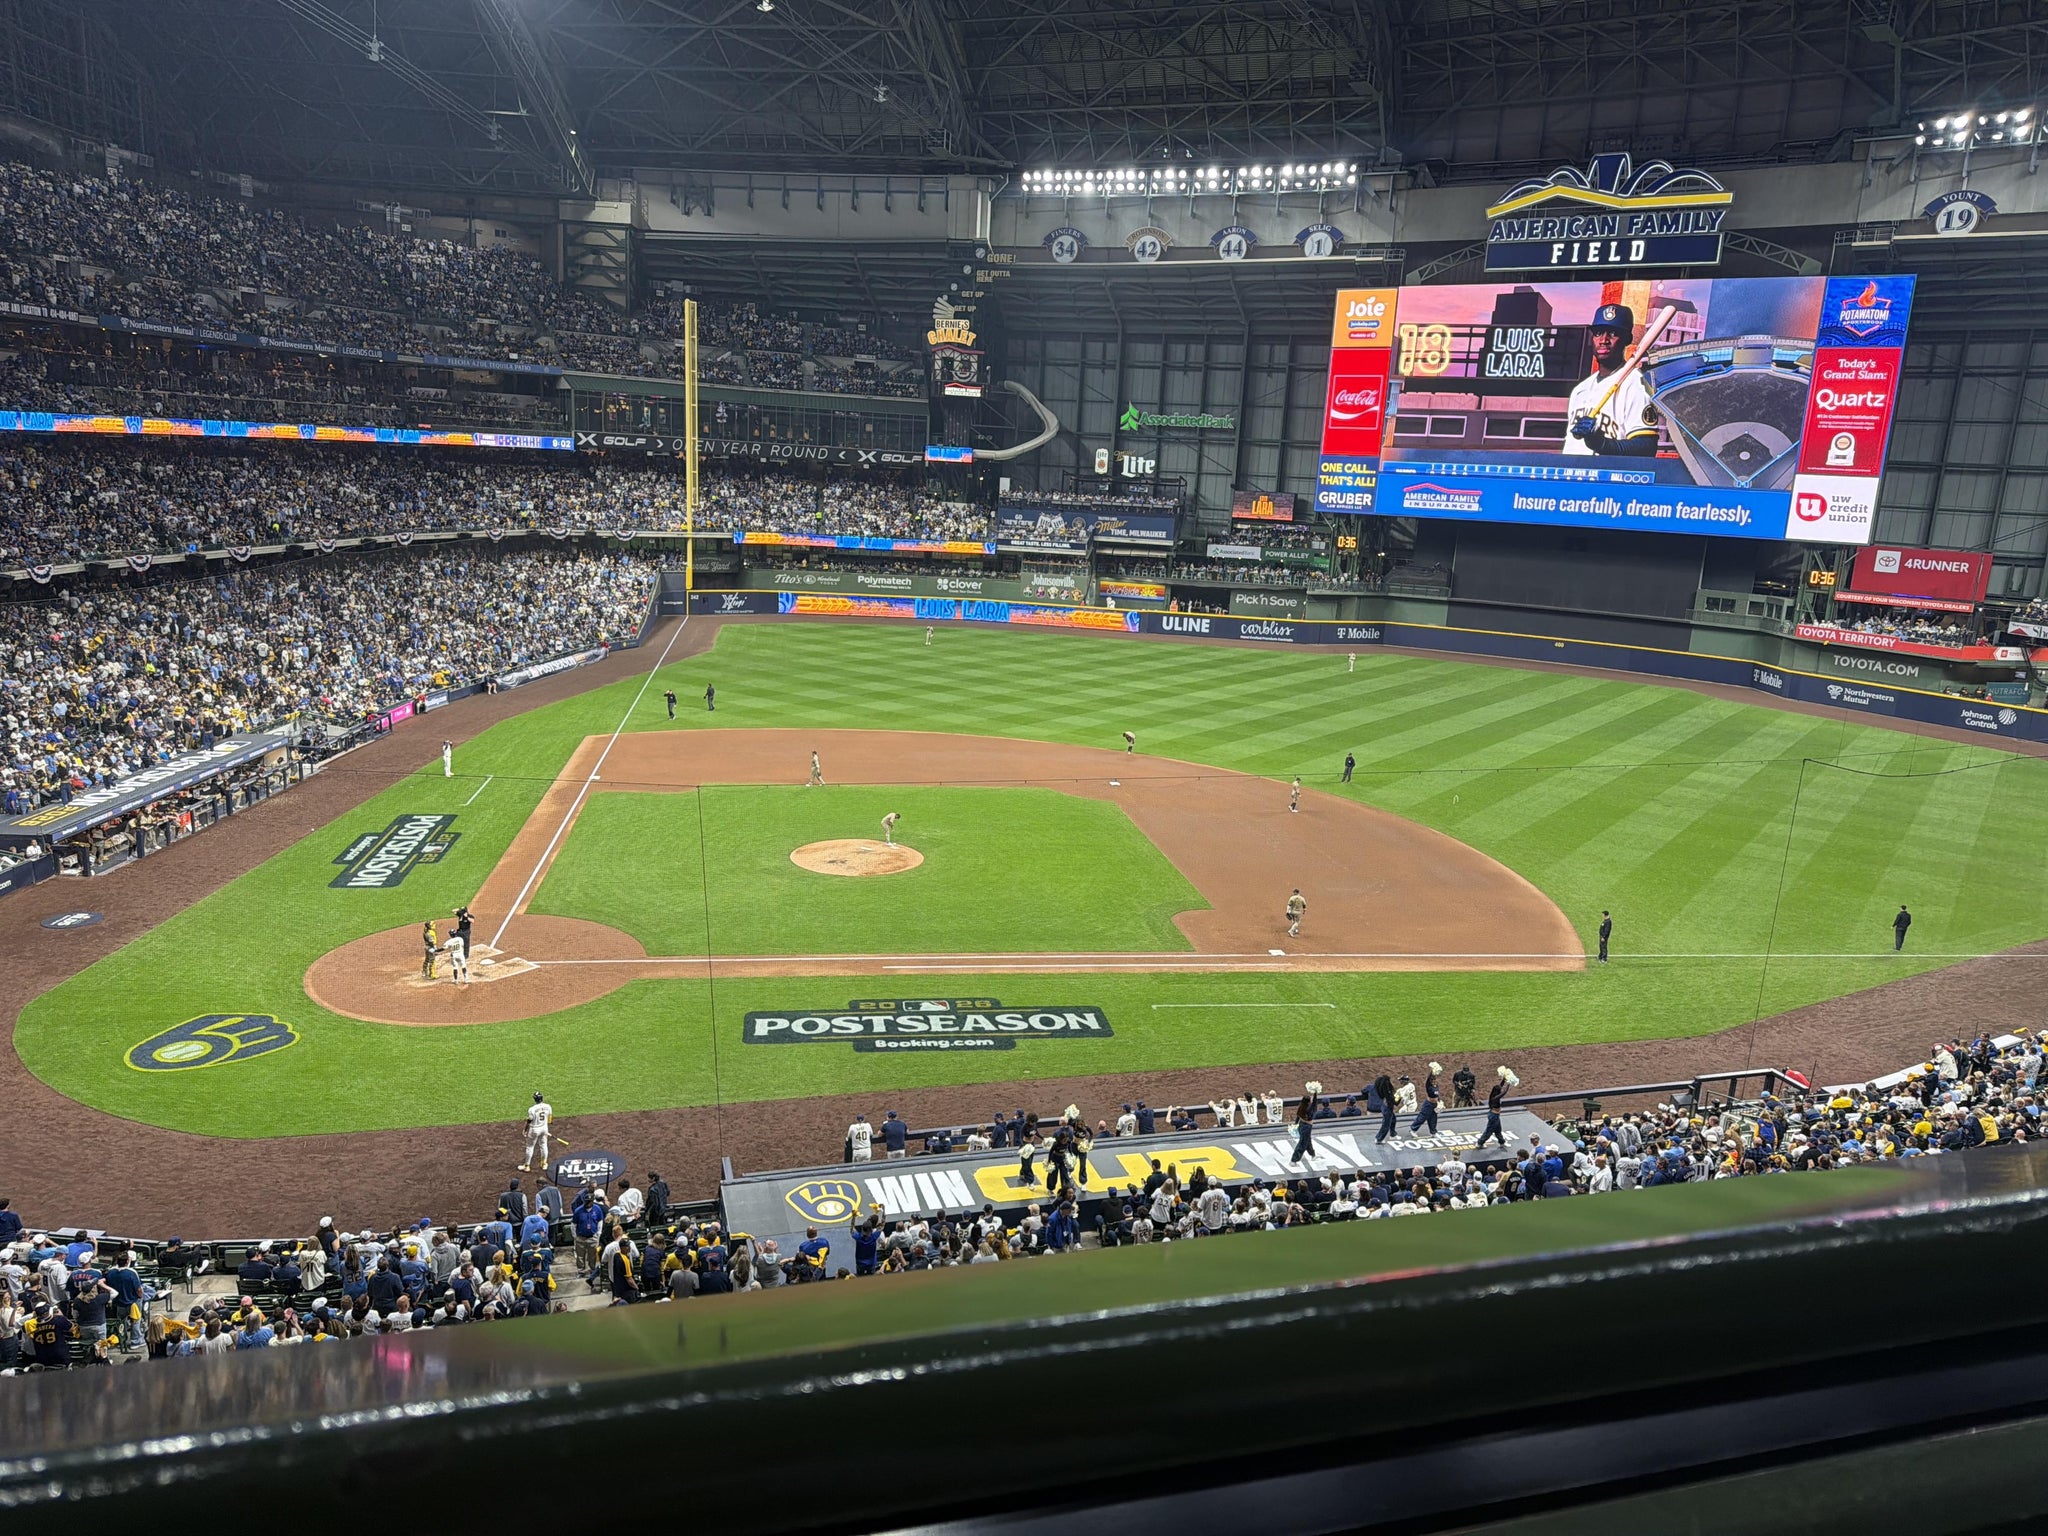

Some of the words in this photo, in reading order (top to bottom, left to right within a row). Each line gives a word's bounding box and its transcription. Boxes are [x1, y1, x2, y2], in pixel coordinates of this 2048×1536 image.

[1942, 191, 1982, 204] YOUNT
[1490, 215, 1619, 241] AMERICAN
[1627, 210, 1726, 235] FAMILY
[1942, 208, 1973, 231] 19
[1051, 230, 1081, 239] FINGERS
[1131, 230, 1166, 239] ROBINSON
[1222, 227, 1247, 236] AARON
[1309, 224, 1331, 232] SELIG
[1055, 241, 1075, 257] 34
[1137, 241, 1157, 258] 42
[1222, 240, 1243, 256] 44
[1314, 238, 1323, 255] 1
[1551, 240, 1645, 264] FIELD
[987, 254, 1016, 263] GONE!
[1346, 296, 1385, 317] Joie
[1840, 309, 1889, 321] POTAWATOMI
[130, 319, 172, 333] Northwestern
[173, 325, 193, 335] Mutual
[200, 329, 223, 340] LEGENDS
[224, 332, 237, 341] CLUB
[936, 320, 969, 329] BERNIE'S
[927, 328, 977, 346] CHALET
[1493, 328, 1544, 353] LUIS
[269, 338, 313, 351] Northwestern
[314, 344, 337, 353] Mutual
[342, 347, 367, 356] LEGENDS
[368, 350, 382, 358] CLUB
[1400, 323, 1450, 376] 18
[1485, 353, 1544, 378] LARA
[1838, 358, 1876, 370] Today's
[1823, 370, 1855, 380] Grand
[1857, 370, 1887, 380] Slam:
[1336, 389, 1379, 405] Coca-Cola
[1816, 388, 1886, 411] Quartz
[21, 412, 54, 430] LARA
[577, 432, 597, 447] X
[603, 437, 647, 447] GOLF
[672, 439, 715, 453] OEN
[722, 442, 761, 455] YEAR
[770, 445, 828, 459] ROUND
[858, 450, 877, 463] X
[881, 454, 922, 464] GOLF
[1121, 455, 1156, 478] Lite
[1321, 463, 1342, 472] ONE
[1344, 464, 1376, 474] CALL...
[1320, 475, 1353, 486] THAT'S
[1355, 476, 1376, 487] ALL!
[1319, 491, 1372, 506] GRUBER
[1404, 492, 1446, 502] AMERICAN
[1449, 495, 1480, 503] FAMILY
[1252, 500, 1274, 515] LARA
[1513, 493, 1556, 511] Insure
[1559, 496, 1623, 517] carefully,
[1626, 501, 1672, 518] dream
[1676, 502, 1752, 526] fearlessly.
[1830, 504, 1868, 514] credit
[1828, 514, 1867, 523] union
[1095, 520, 1128, 531] Miller
[1111, 529, 1128, 537] TIME,
[1128, 530, 1167, 538] MILWAUKEE
[1337, 536, 1356, 549] 0:36
[1265, 551, 1289, 559] POWER
[1290, 551, 1309, 559] ALLEY
[1904, 558, 1969, 573] 4RUNNER
[774, 574, 802, 584] Tito's
[858, 576, 912, 586] Polymatech
[949, 578, 982, 590] clover
[1032, 576, 1075, 588] Johnsonville
[1810, 571, 1835, 586] 0:36
[1106, 585, 1140, 596] Surfside
[1272, 597, 1298, 607] Save
[1888, 597, 1920, 606] WISCONSIN
[915, 599, 955, 618] LUIS
[961, 600, 1010, 621] LARA
[1162, 615, 1210, 633] ULINE
[1241, 621, 1295, 636] carbliss
[1348, 627, 1380, 639] Mobile
[1799, 626, 1837, 641] TOYOTA
[1839, 631, 1896, 648] TERRITORY
[1833, 655, 1919, 677] TOYOTA.COM
[1760, 670, 1783, 688] Mobile
[1843, 694, 1869, 705] Mutual
[1845, 687, 1894, 703] Northwestern
[1960, 709, 1993, 721] Johnson
[1965, 717, 1998, 730] Controls
[347, 815, 443, 886] POSTSEASON
[859, 1002, 896, 1010] 20
[955, 1000, 990, 1008] 26
[754, 1013, 1102, 1036] POSTSEASON
[876, 1037, 994, 1049] Booking.com
[539, 1112, 545, 1121] 5
[1246, 1105, 1254, 1115] 10
[1225, 1114, 1231, 1123] 9
[1127, 1123, 1133, 1132] 6
[855, 1131, 867, 1142] 40
[558, 1162, 613, 1175] NLDS
[1625, 1168, 1638, 1178] 32
[864, 1169, 976, 1214] WIN
[974, 1145, 1254, 1202] OUR
[1213, 1201, 1219, 1211] 8
[35, 1332, 56, 1344] 49
